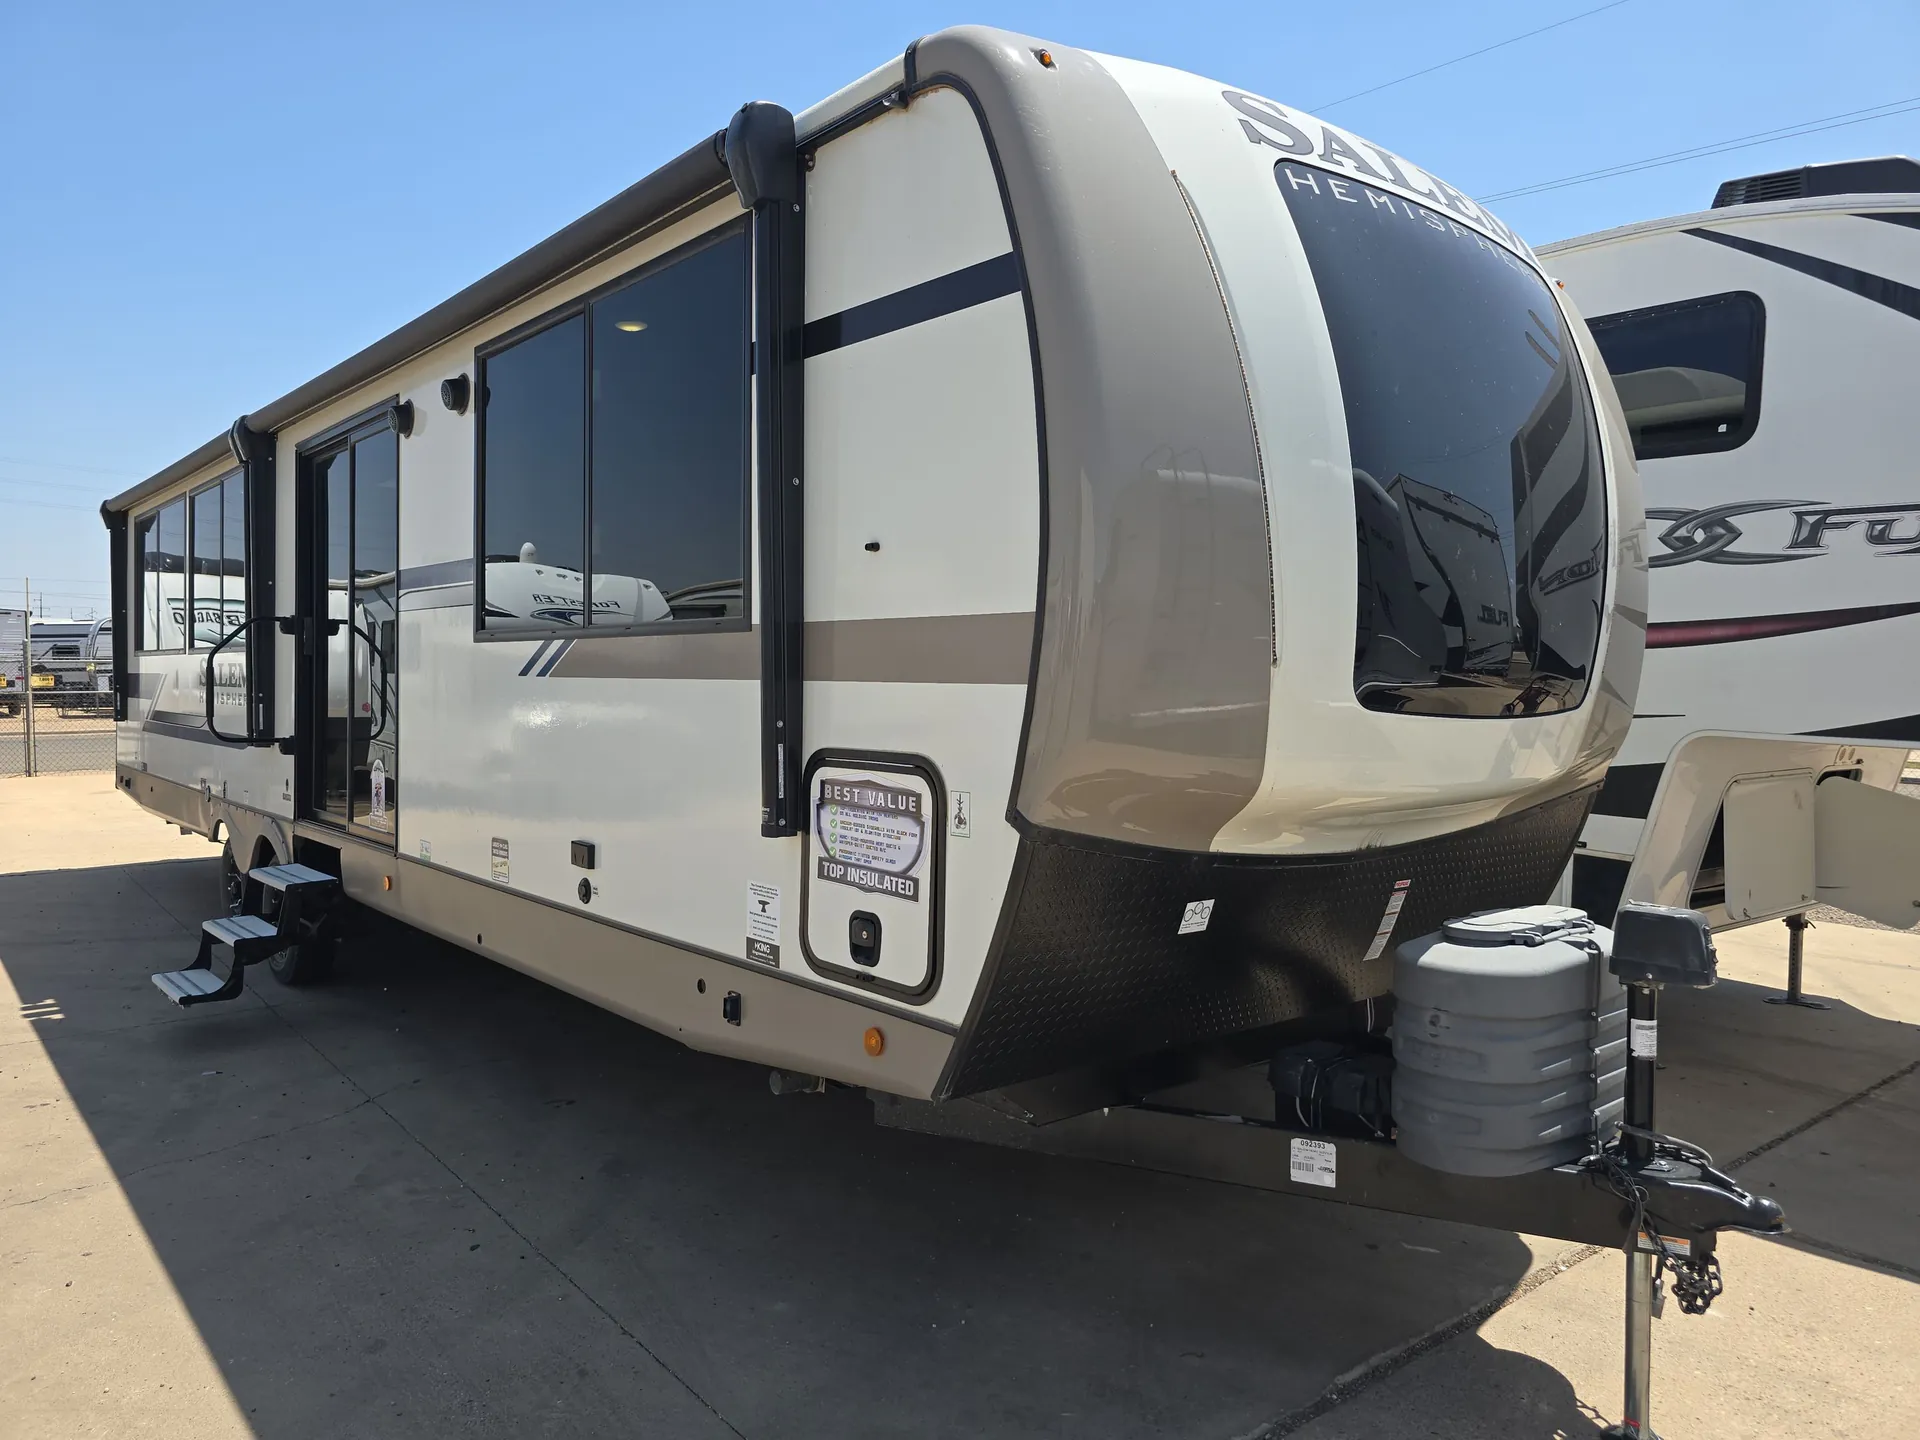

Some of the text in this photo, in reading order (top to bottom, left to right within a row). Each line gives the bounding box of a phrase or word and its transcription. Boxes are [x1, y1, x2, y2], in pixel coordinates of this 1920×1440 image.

[1221, 90, 1545, 273] SALEM
[824, 784, 860, 803] BEST
[868, 790, 917, 812] VALUE
[822, 861, 915, 896] TOP INSULATED
[1300, 1140, 1326, 1150] 092393
